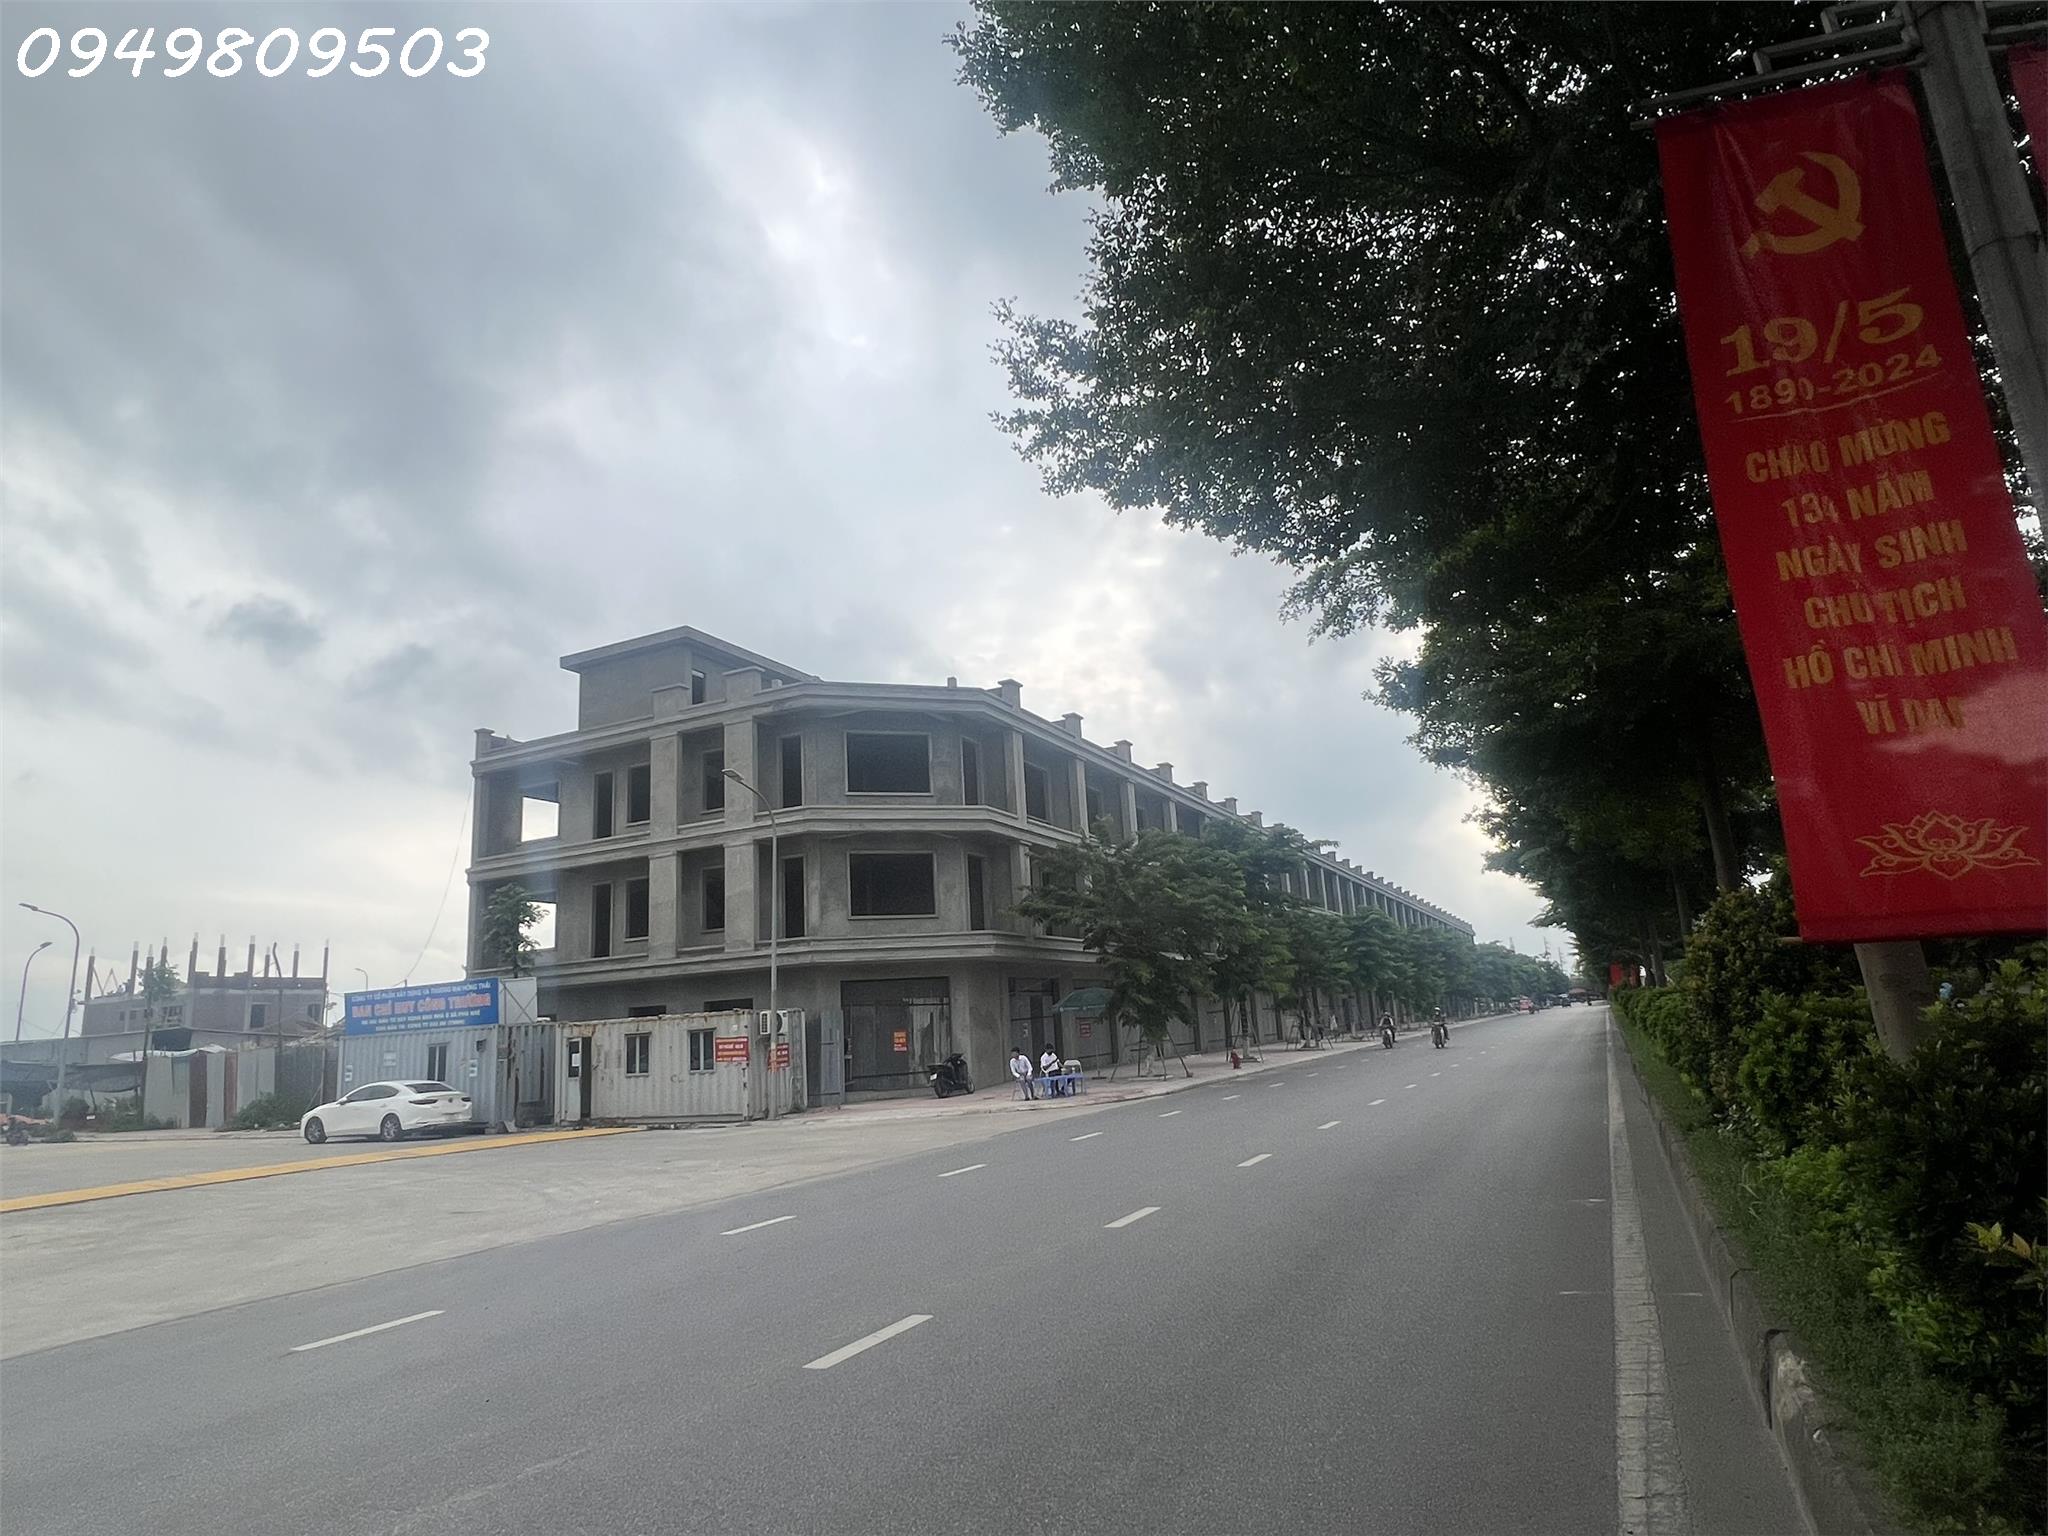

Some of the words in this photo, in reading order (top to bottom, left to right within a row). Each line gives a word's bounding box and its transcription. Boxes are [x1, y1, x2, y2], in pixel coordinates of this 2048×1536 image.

[1721, 287, 1924, 377] 19/5
[1846, 470, 1935, 520] NĂM
[1775, 534, 1863, 580] NGÀY
[1874, 519, 1969, 569] SINH
[1878, 575, 1967, 629] TỊCH
[1782, 639, 1835, 689] HỒ
[1909, 626, 2019, 677] MINH
[1856, 693, 1897, 736] VĨ
